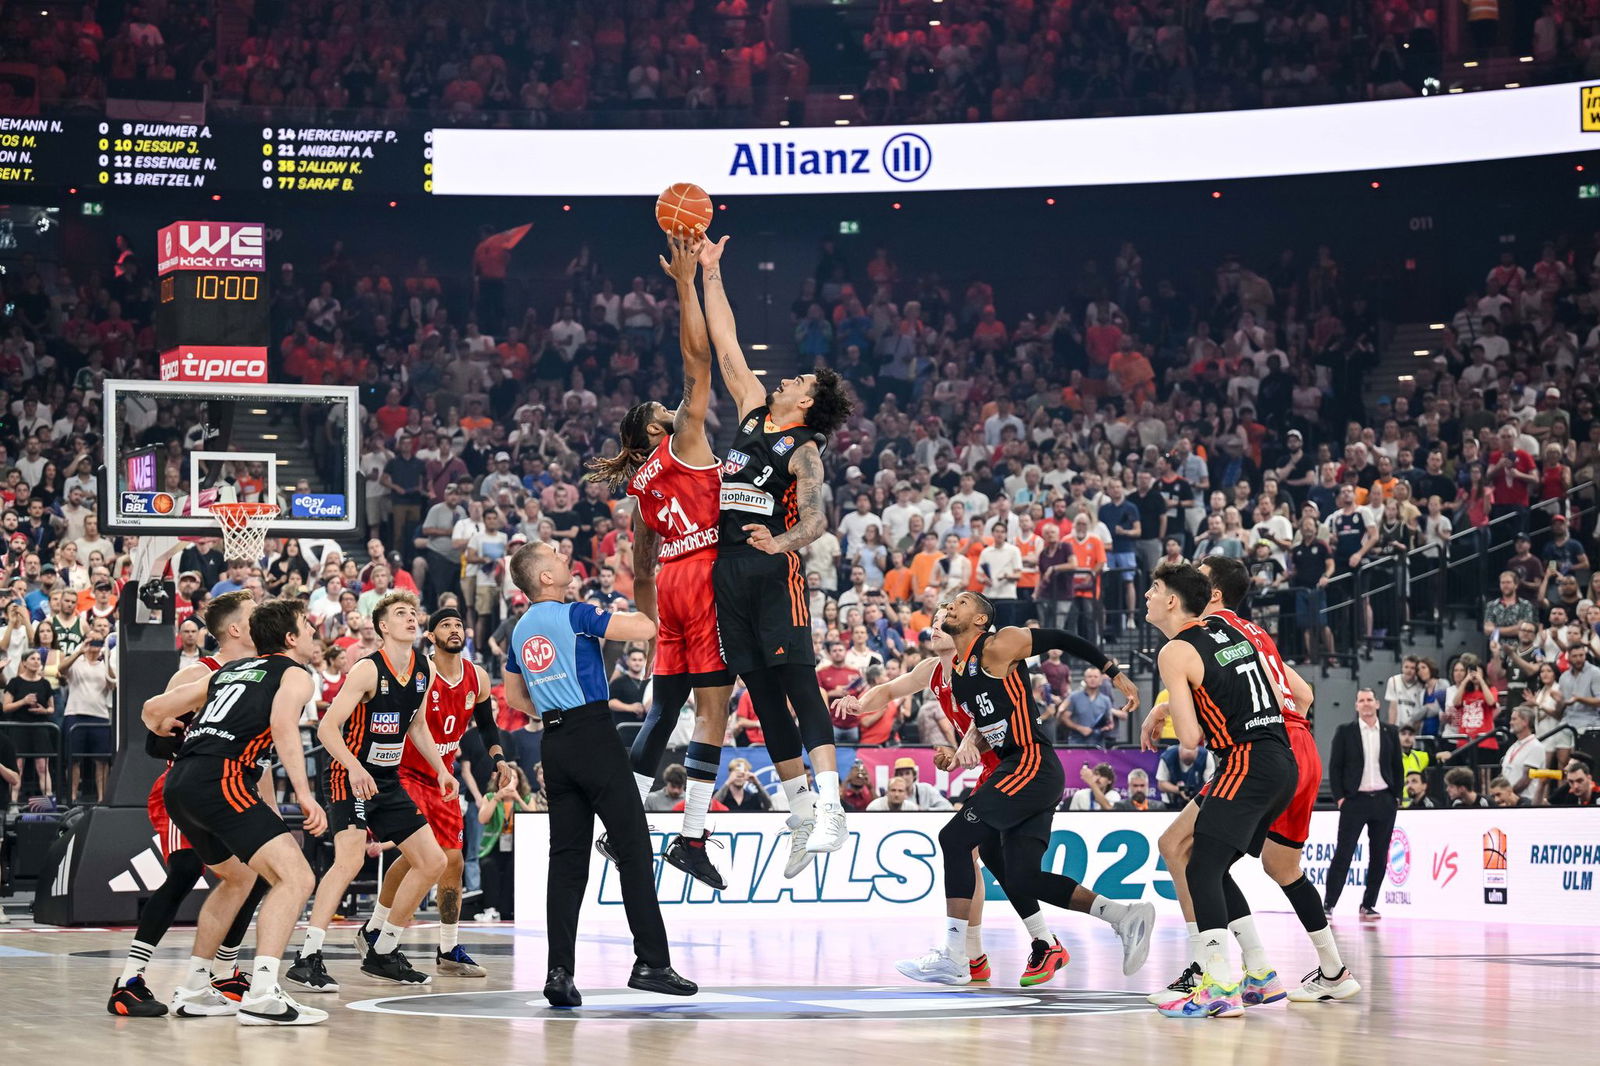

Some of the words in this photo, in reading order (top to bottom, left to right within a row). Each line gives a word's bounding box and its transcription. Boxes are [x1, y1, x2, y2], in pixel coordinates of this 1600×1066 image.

[50, 121, 64, 133] N.
[98, 122, 109, 135] 0
[122, 123, 132, 136] 9
[134, 124, 198, 138] PLUMMER
[262, 127, 273, 140] 0
[277, 128, 296, 141] 14
[297, 129, 383, 143] HERKENHOFF
[384, 130, 398, 143] P.
[0, 134, 20, 147] OS
[22, 136, 37, 148] M.
[98, 138, 109, 151] 0
[114, 139, 132, 152] 10
[134, 140, 185, 153] JESSUP
[187, 142, 199, 154] J.
[19, 151, 32, 164] N.
[262, 144, 273, 156] 0
[277, 144, 295, 157] 21
[297, 145, 361, 158] ANIGBATA
[729, 142, 870, 176] Allianz
[98, 154, 109, 167] 0
[114, 155, 132, 168] 12
[134, 156, 202, 170] ESSENGUE
[204, 158, 217, 171] N.
[262, 159, 273, 172] 0
[277, 160, 295, 173] 35
[297, 161, 348, 174] JALLOW
[349, 162, 363, 174] K.
[23, 168, 35, 181] T.
[98, 171, 109, 184] 0
[114, 172, 132, 185] 13
[134, 173, 192, 187] BRETZEL
[262, 176, 273, 189] 0
[277, 177, 295, 190] 77
[297, 177, 341, 190] SARAF
[342, 178, 355, 191] B.
[179, 225, 263, 255] WE
[180, 257, 213, 267] KICK
[215, 258, 228, 267] IT
[196, 275, 258, 300] 10:00
[182, 352, 265, 380] tipico
[753, 465, 774, 487] 3
[125, 503, 148, 513] BBL
[308, 504, 342, 515] Credit
[1235, 661, 1272, 713] 77
[199, 683, 247, 724] 10
[975, 691, 995, 717] 35
[373, 713, 399, 724] LIQUI
[443, 715, 456, 735] 0
[372, 723, 398, 733] MOLY
[1302, 843, 1314, 862] C
[1315, 844, 1363, 862] BAYN
[1529, 844, 1600, 865] RATIOPHA
[982, 829, 1179, 901] 02
[1432, 843, 1458, 889] VS
[1562, 871, 1593, 890] ULM
